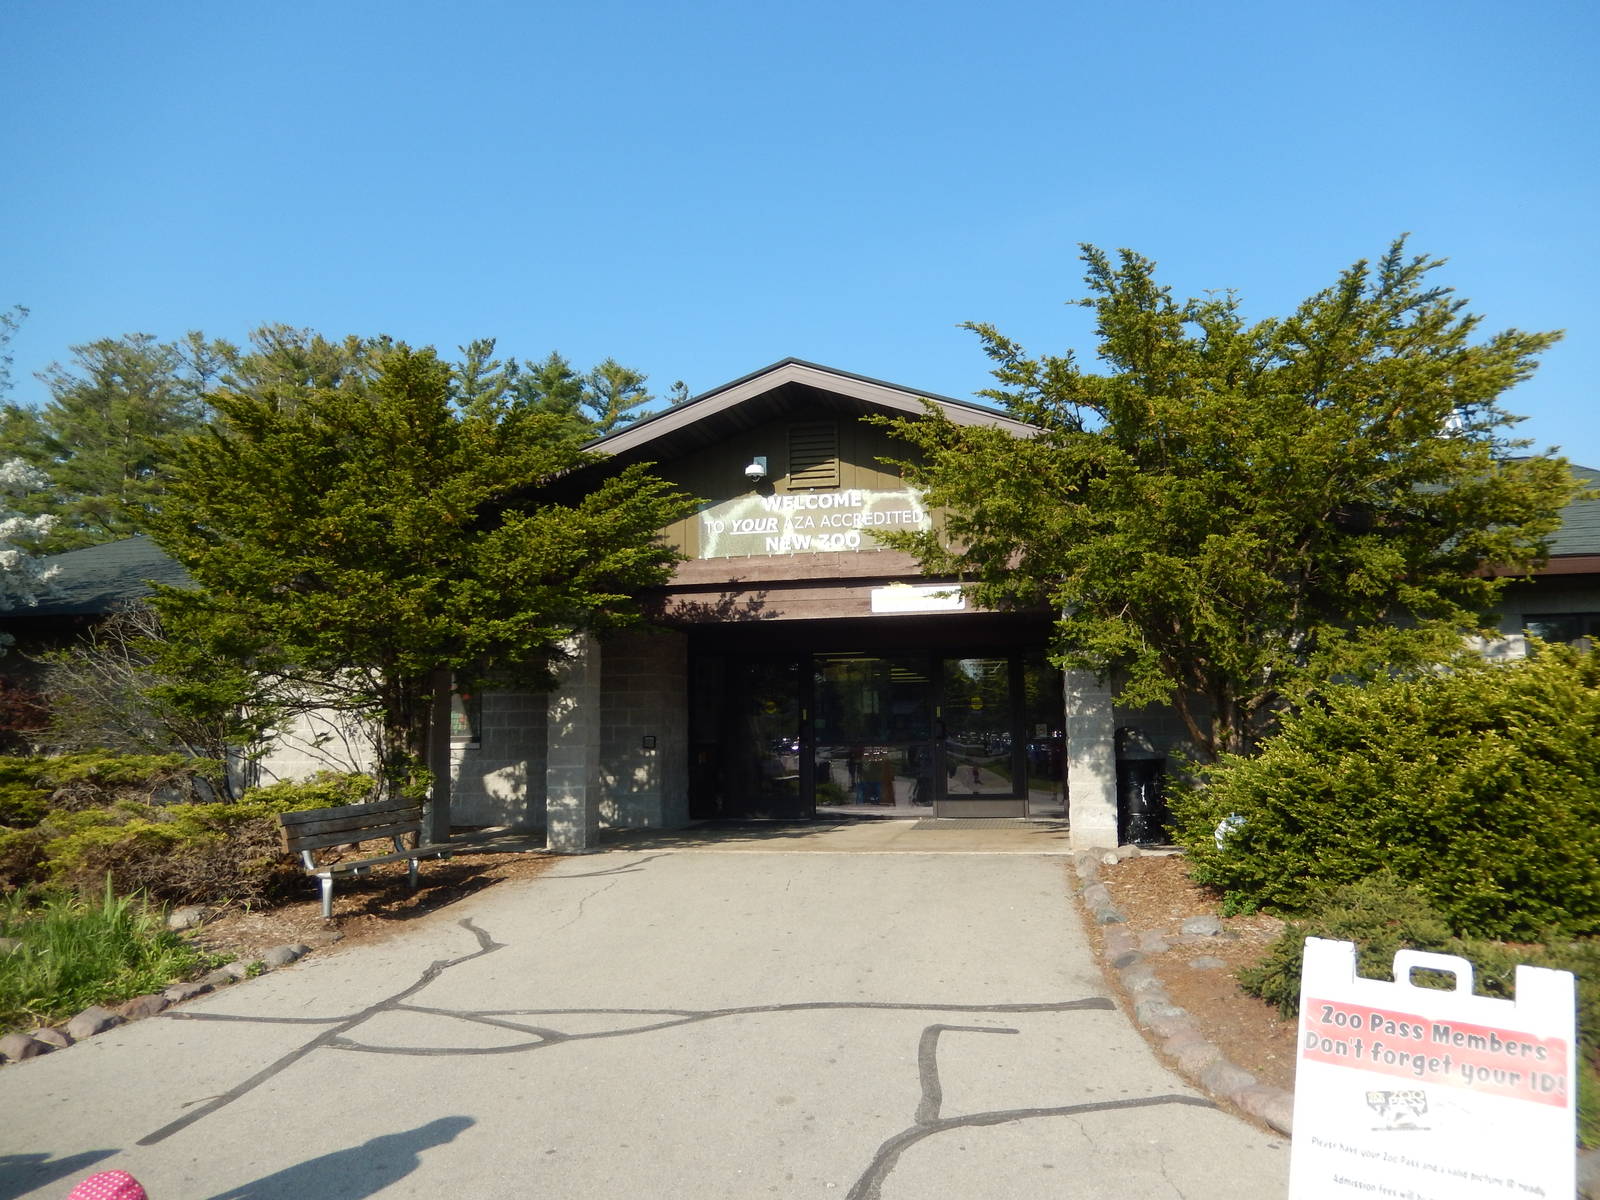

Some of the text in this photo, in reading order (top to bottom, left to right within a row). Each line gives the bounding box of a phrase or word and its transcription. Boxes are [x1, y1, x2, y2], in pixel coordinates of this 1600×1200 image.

[761, 493, 861, 511] WELCOME
[704, 510, 924, 535] TO YOUR AZA ACCREDITED
[765, 532, 861, 551] NEW ZOO
[1321, 1005, 1548, 1061] Zoo Pass Members
[1305, 1031, 1566, 1096] Don't forget your ID!
